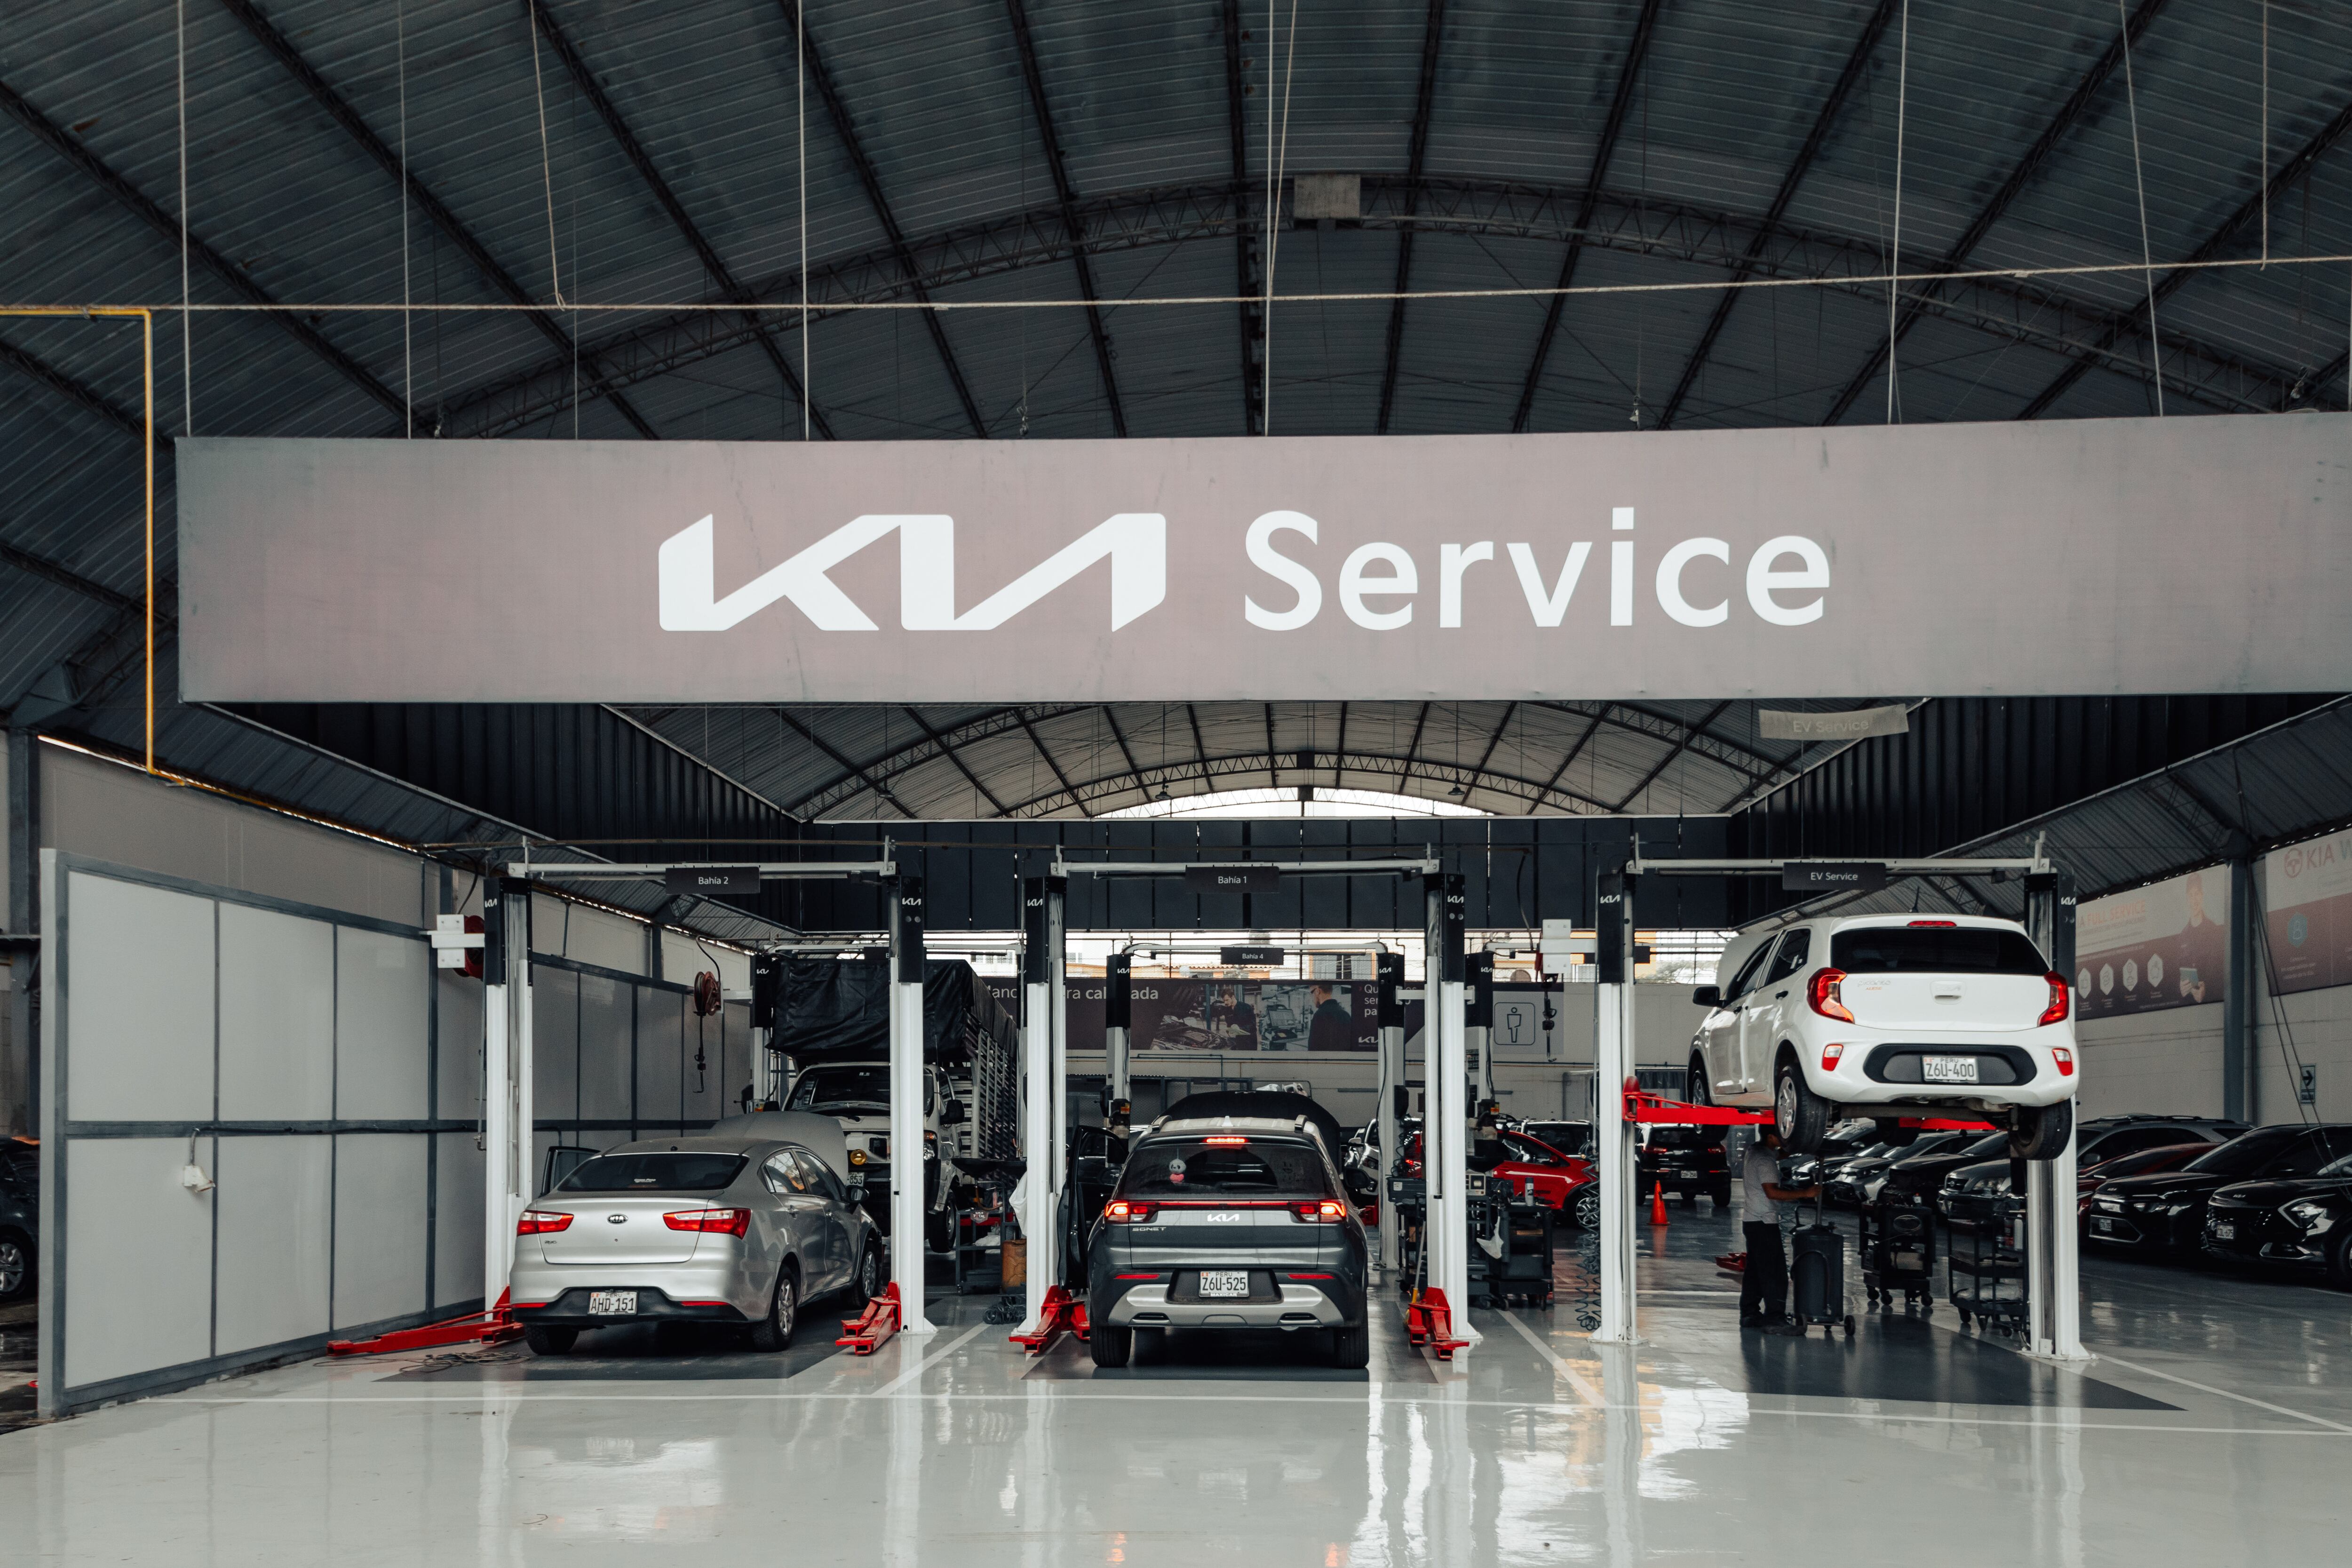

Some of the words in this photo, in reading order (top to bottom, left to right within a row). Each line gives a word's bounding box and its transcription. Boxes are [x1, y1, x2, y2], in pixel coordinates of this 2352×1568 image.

[659, 513, 1167, 632] KIA
[1244, 506, 1831, 631] Service
[1793, 720, 1811, 732] EV
[1816, 719, 1869, 732] Service
[2307, 844, 2335, 869] KIA
[1926, 1063, 1974, 1077] Z6U-400
[1202, 1277, 1246, 1291] Z6U-525
[591, 1298, 634, 1311] AHD-151
